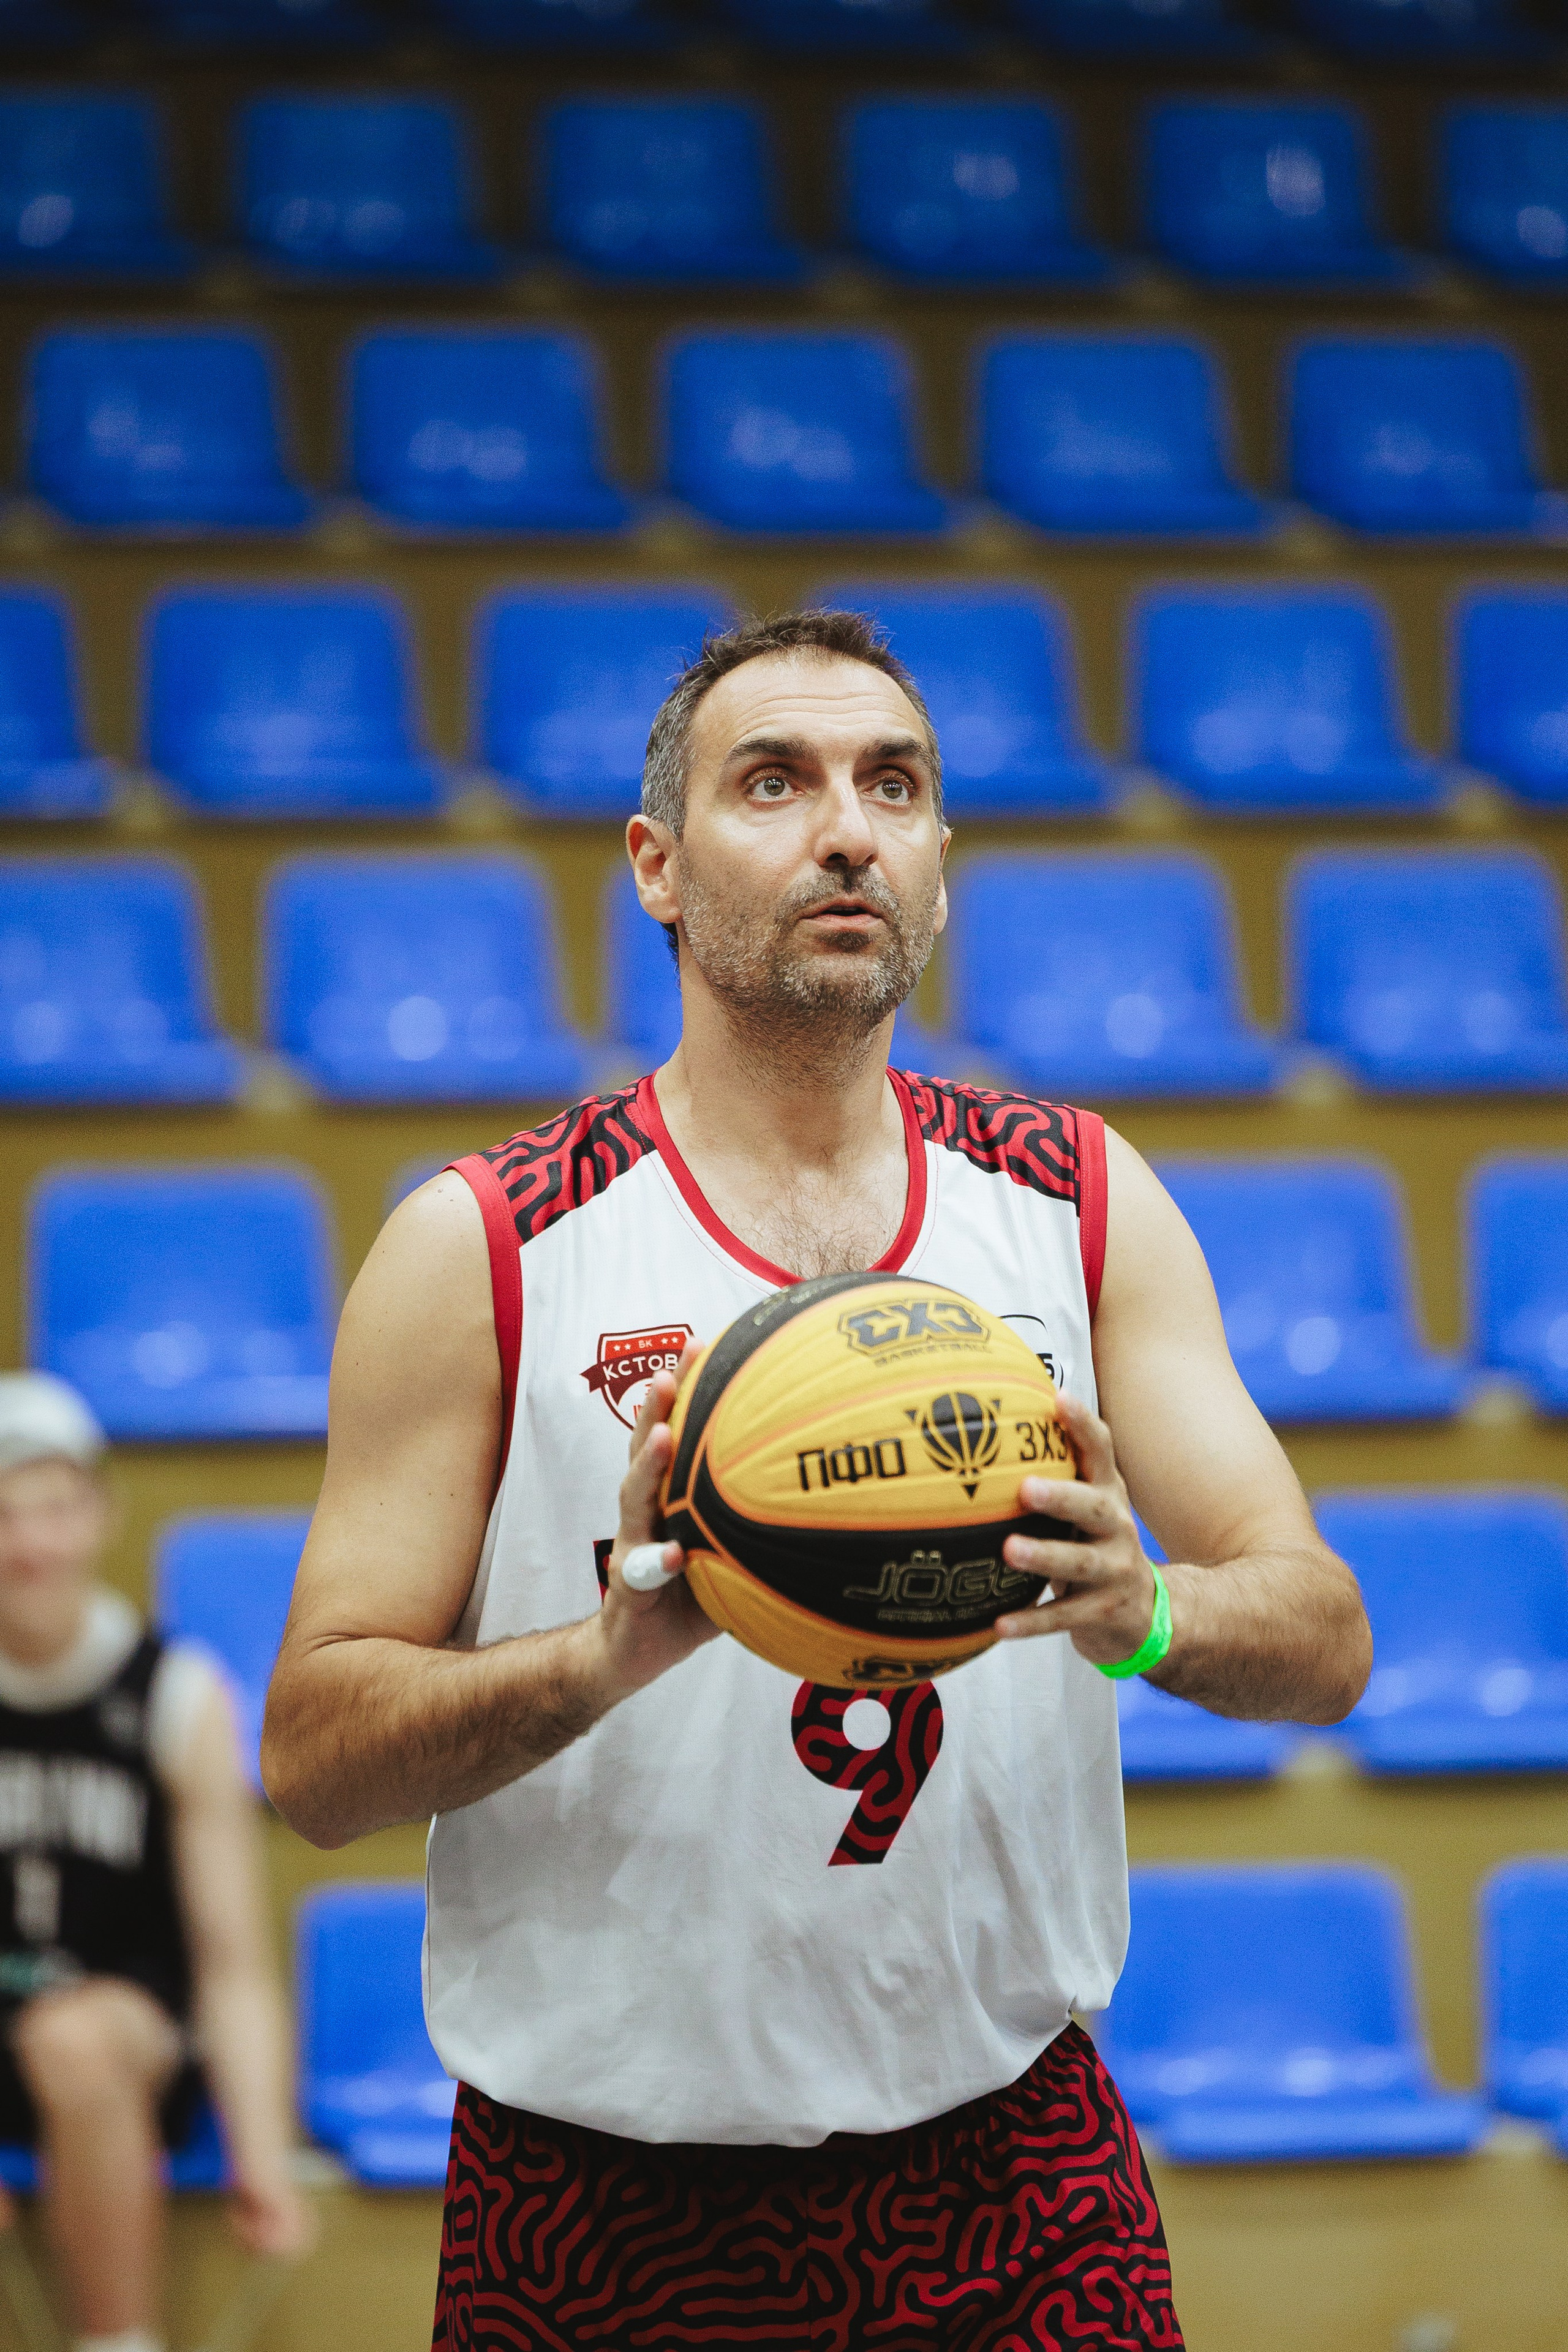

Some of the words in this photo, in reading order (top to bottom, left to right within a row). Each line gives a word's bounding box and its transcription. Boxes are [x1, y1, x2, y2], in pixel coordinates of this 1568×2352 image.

[603, 1354, 679, 1381] КСТОВ
[798, 1438, 907, 1491] ПФО
[843, 1550, 1035, 1606] JÖGE
[791, 1680, 944, 1866] 9
